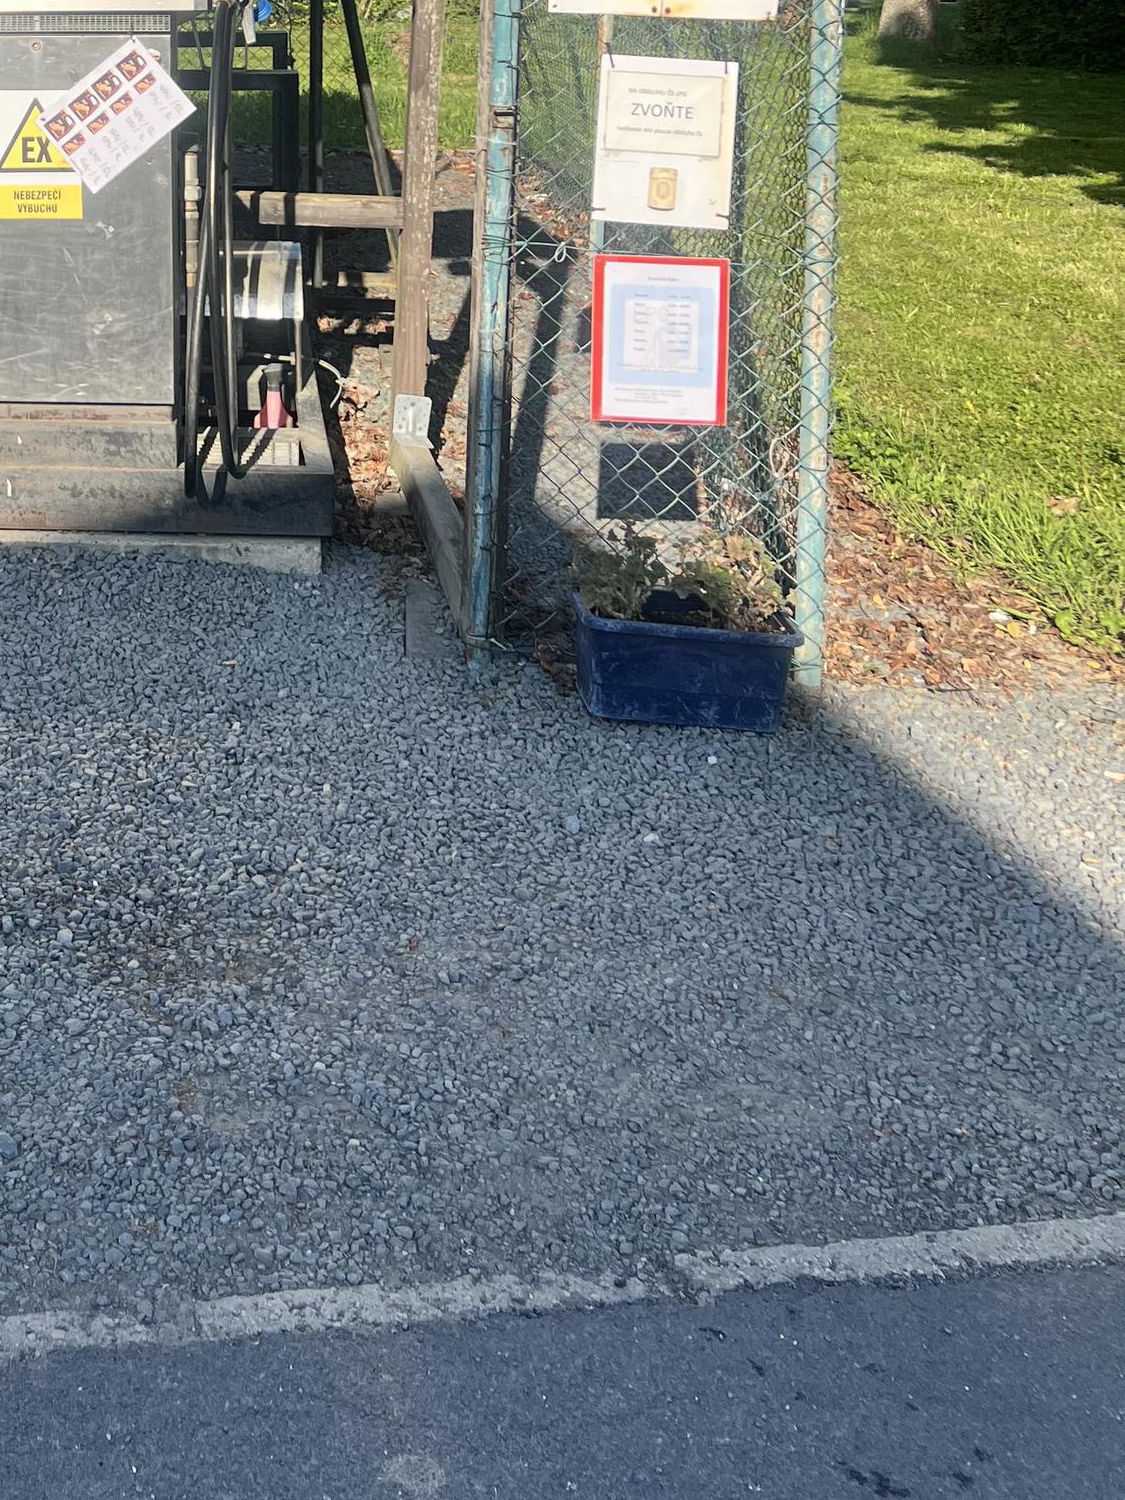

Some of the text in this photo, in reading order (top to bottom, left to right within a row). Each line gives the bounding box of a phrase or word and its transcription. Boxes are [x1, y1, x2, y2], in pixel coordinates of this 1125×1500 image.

[631, 101, 694, 119] ZVOŇTE
[22, 137, 52, 163] EX
[13, 190, 61, 200] NEBEZPEČÍ
